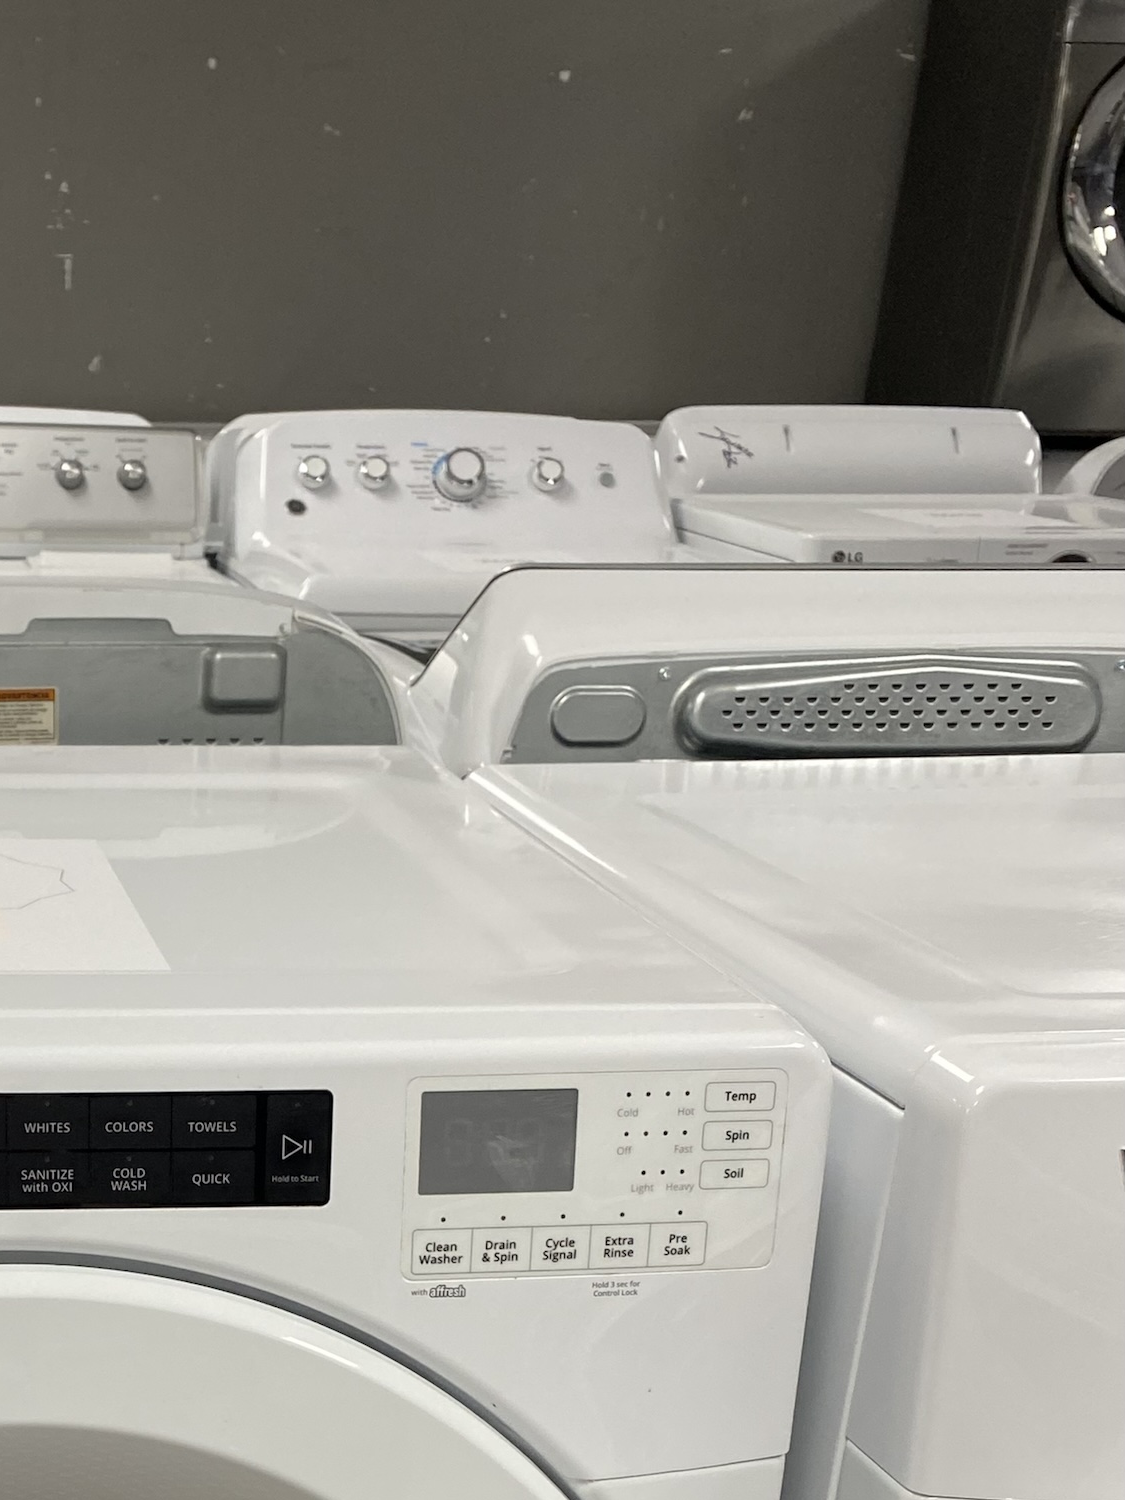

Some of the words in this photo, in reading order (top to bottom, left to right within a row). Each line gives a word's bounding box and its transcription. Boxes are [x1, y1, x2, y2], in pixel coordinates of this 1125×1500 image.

[725, 1091, 757, 1104] Temp
[617, 1108, 639, 1118] Cold
[677, 1107, 695, 1116] Hot
[24, 1122, 71, 1133] WHITES
[105, 1121, 154, 1133] COLORS
[187, 1121, 237, 1133] TOWELS
[725, 1130, 750, 1143] Spin
[616, 1146, 632, 1156] Off
[674, 1145, 694, 1154] Fast
[20, 1169, 75, 1181] SANITIZE
[112, 1168, 146, 1179] COLD
[192, 1173, 231, 1185] QUICK
[271, 1175, 290, 1183] Hold
[300, 1175, 320, 1183] Start
[724, 1168, 744, 1179] Soil
[22, 1181, 49, 1193] with
[53, 1182, 73, 1193] OXI
[111, 1180, 147, 1191] WASH
[631, 1184, 654, 1195] Light
[665, 1182, 695, 1193] Heavy
[545, 1238, 576, 1250] Cycle
[604, 1236, 635, 1247] Extra
[669, 1233, 688, 1244] Pre
[425, 1241, 458, 1252] Clean
[485, 1240, 517, 1251] Drain
[663, 1244, 691, 1256] Soak
[481, 1252, 490, 1263] &
[493, 1251, 519, 1265] Spin
[542, 1249, 577, 1263] Signal
[603, 1247, 635, 1259] Rinse
[419, 1253, 463, 1265] Washer
[591, 1281, 610, 1289] Hold
[629, 1280, 641, 1288] for
[429, 1284, 466, 1298] affresh
